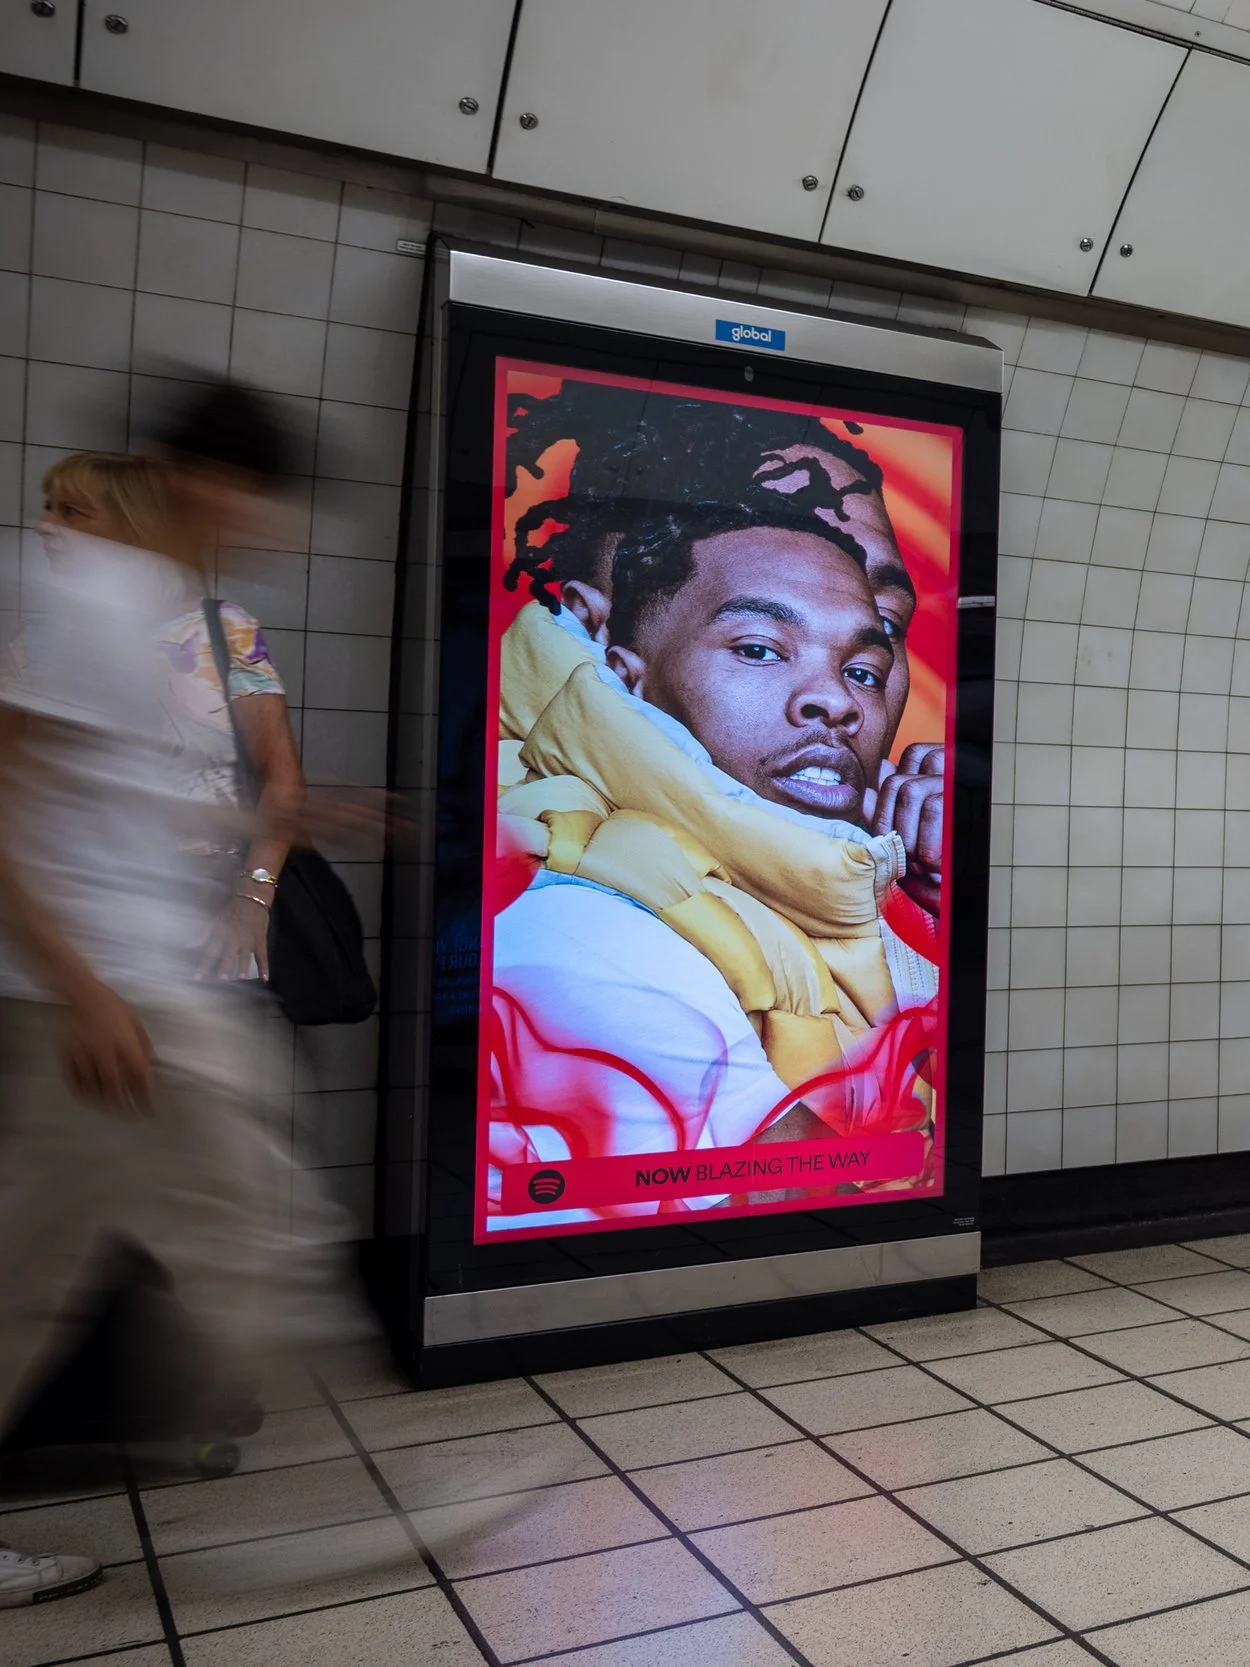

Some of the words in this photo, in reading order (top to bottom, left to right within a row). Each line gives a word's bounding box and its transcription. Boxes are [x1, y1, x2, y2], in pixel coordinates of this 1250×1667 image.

[732, 325, 772, 343] global
[635, 1165, 692, 1187] NOW
[695, 1157, 783, 1182] BLAZING
[787, 1153, 825, 1173] THE
[828, 1149, 872, 1169] WAY
